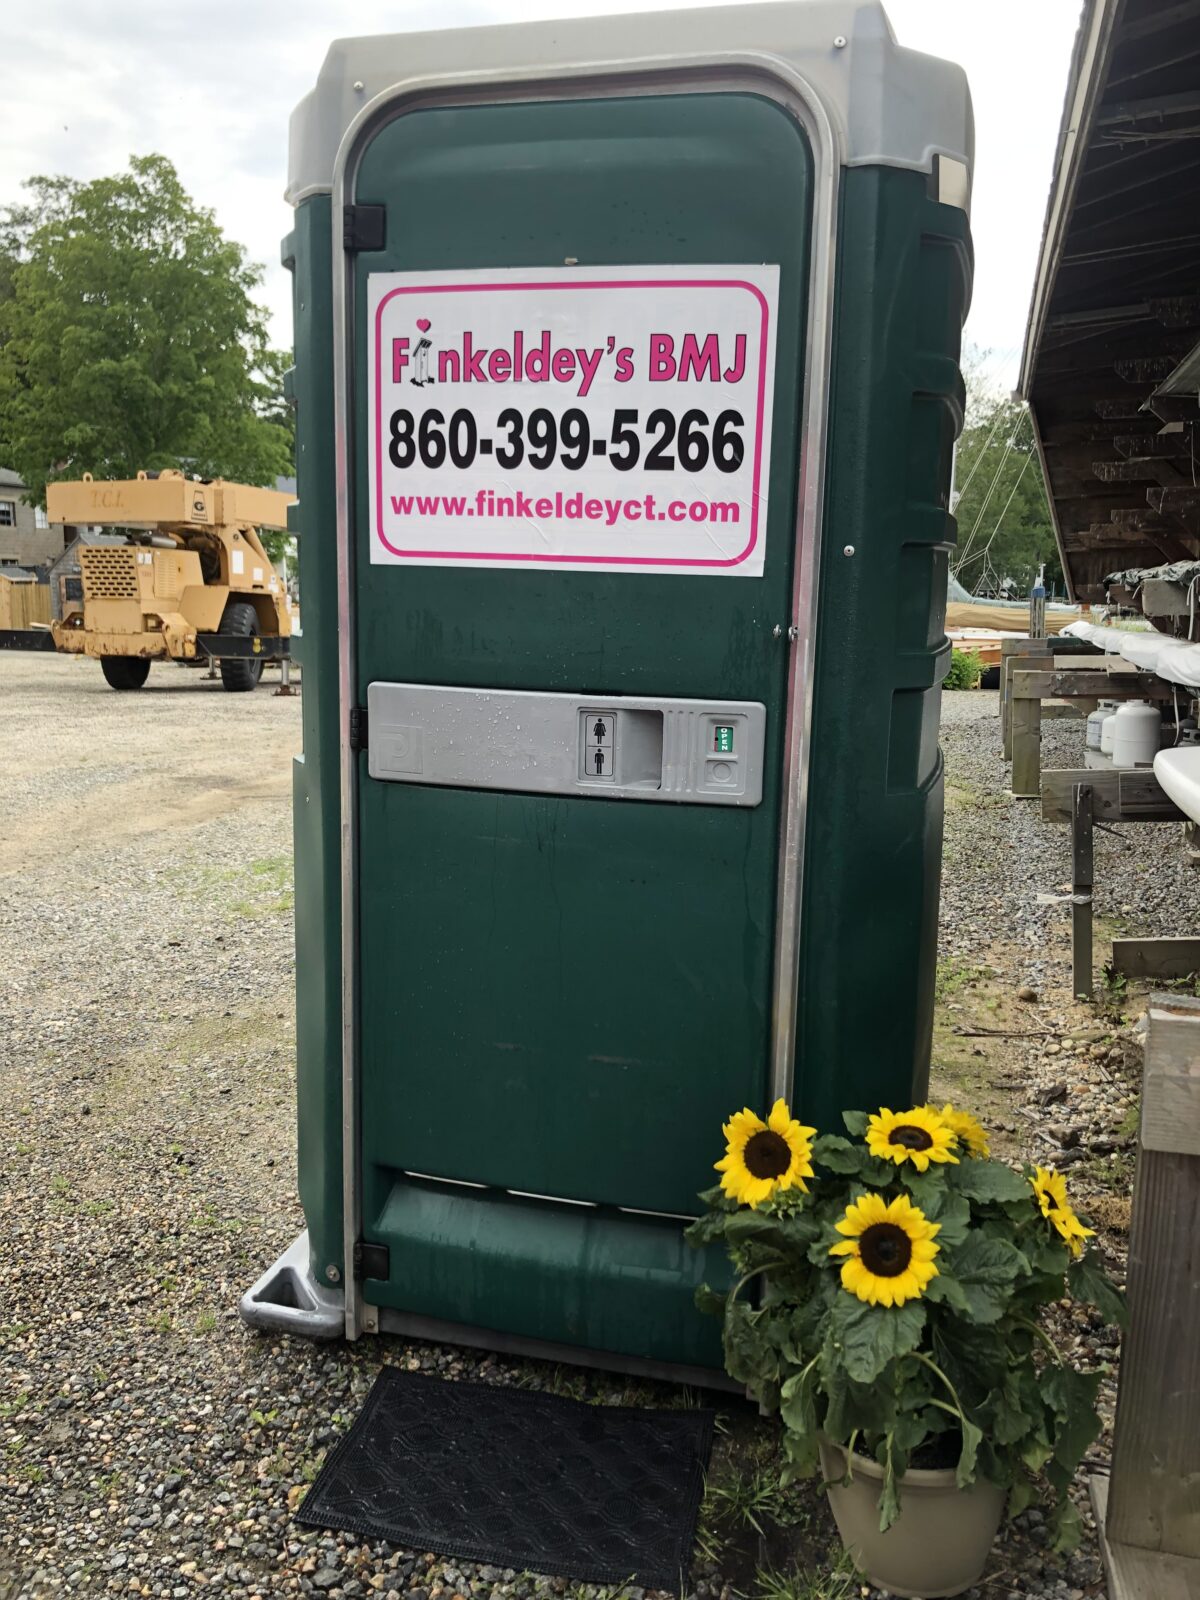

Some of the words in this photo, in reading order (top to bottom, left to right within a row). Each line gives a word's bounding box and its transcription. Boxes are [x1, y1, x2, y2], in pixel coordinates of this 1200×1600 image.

[649, 333, 747, 383] BMJ
[388, 407, 745, 473] 860-399-5266
[390, 490, 740, 526] www.finkeldeyct.com
[720, 728, 728, 751] OPEN
